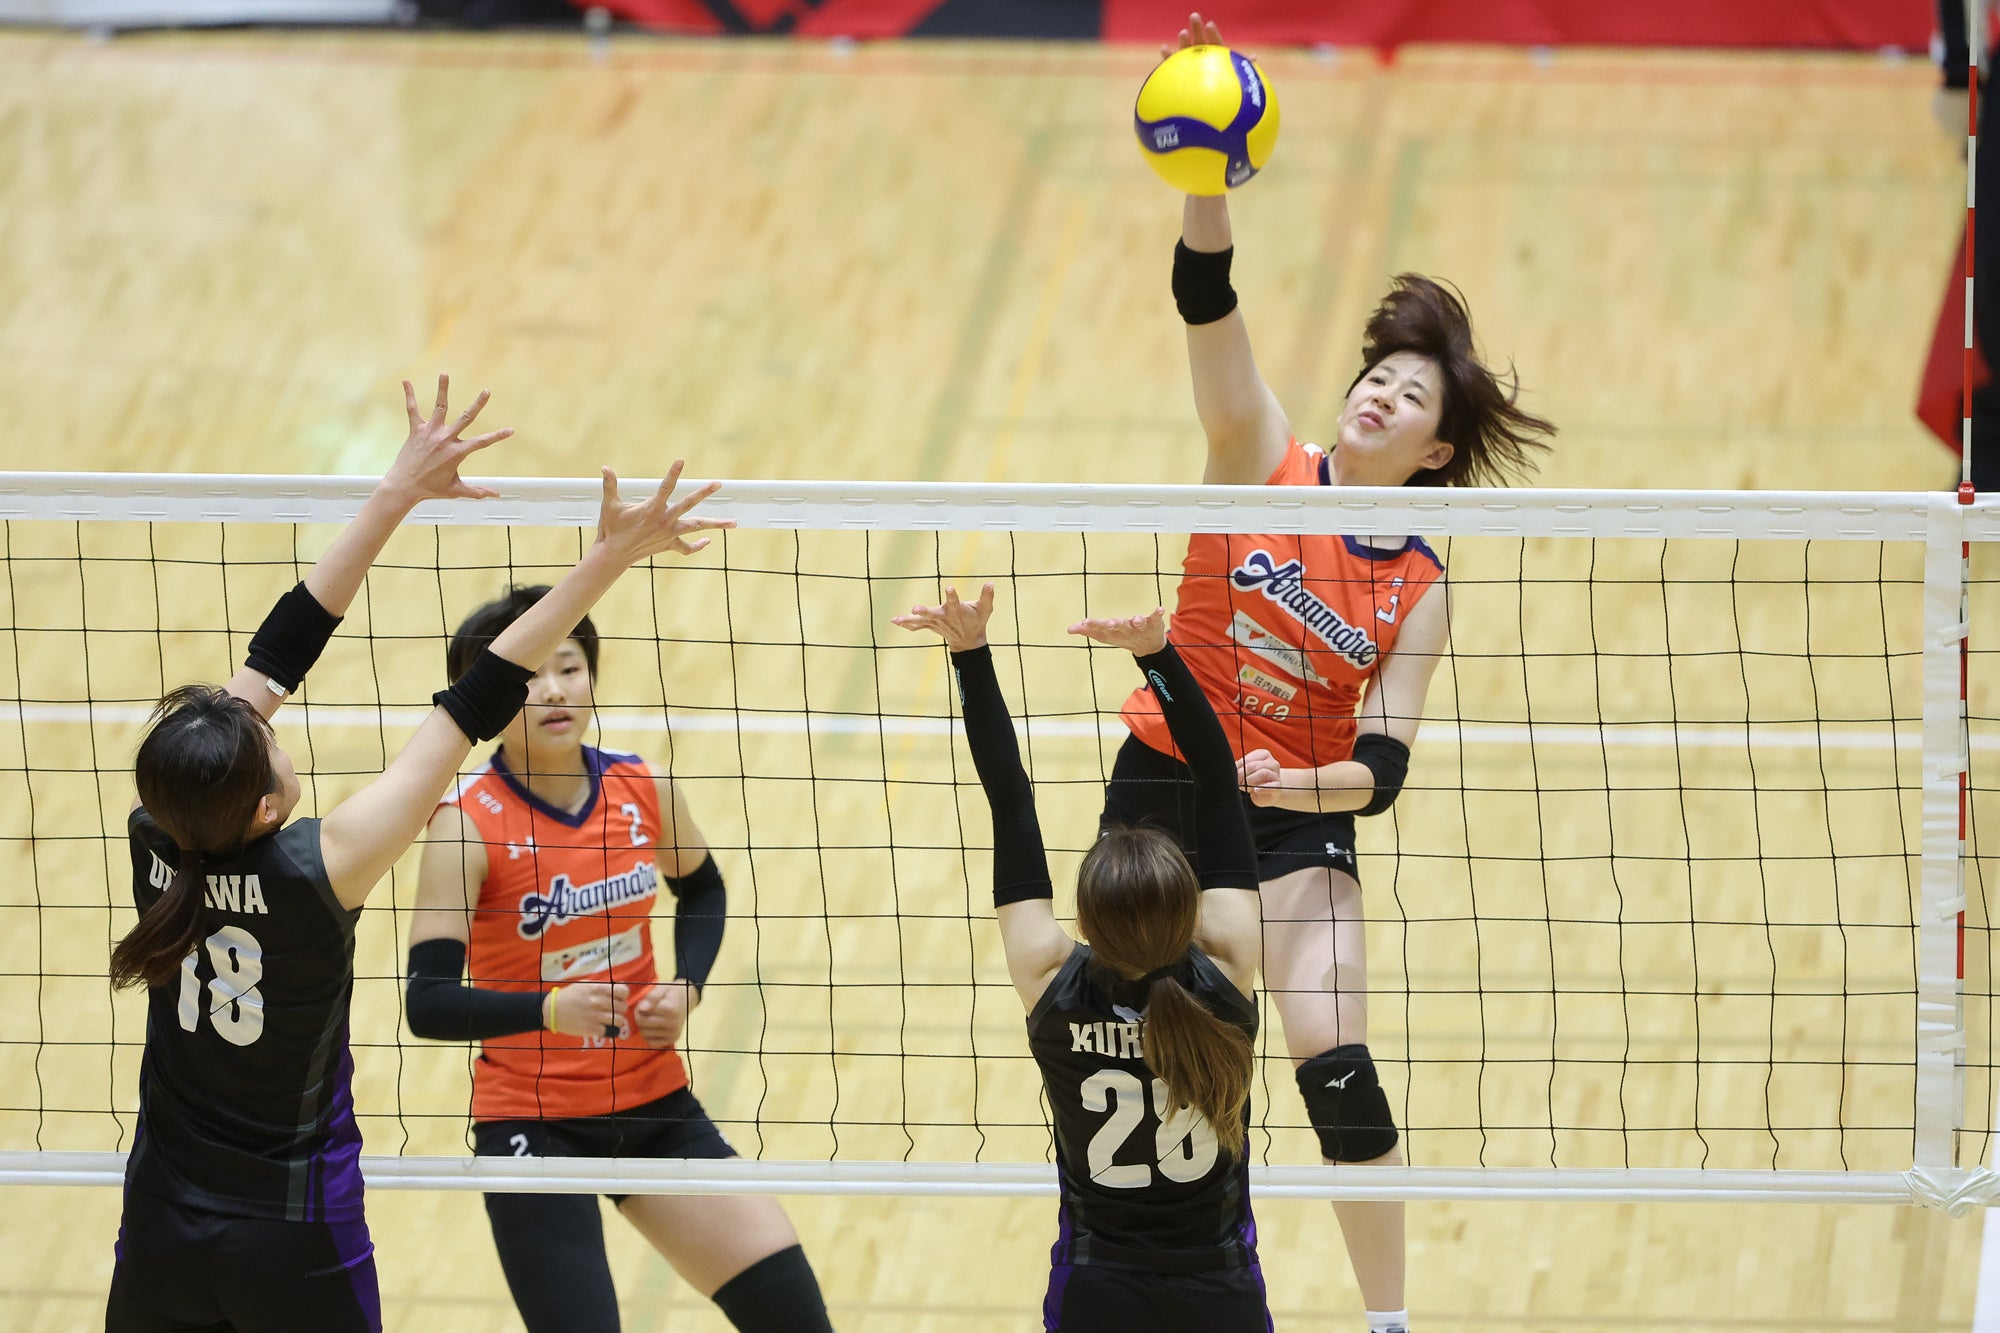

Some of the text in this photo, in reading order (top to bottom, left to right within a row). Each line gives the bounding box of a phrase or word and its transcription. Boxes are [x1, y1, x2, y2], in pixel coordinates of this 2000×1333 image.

[1231, 550, 1378, 669] Aranmare
[621, 802, 649, 847] 2
[178, 925, 264, 1047] 18
[1069, 1021, 1145, 1060] KUR
[509, 1133, 534, 1158] 2
